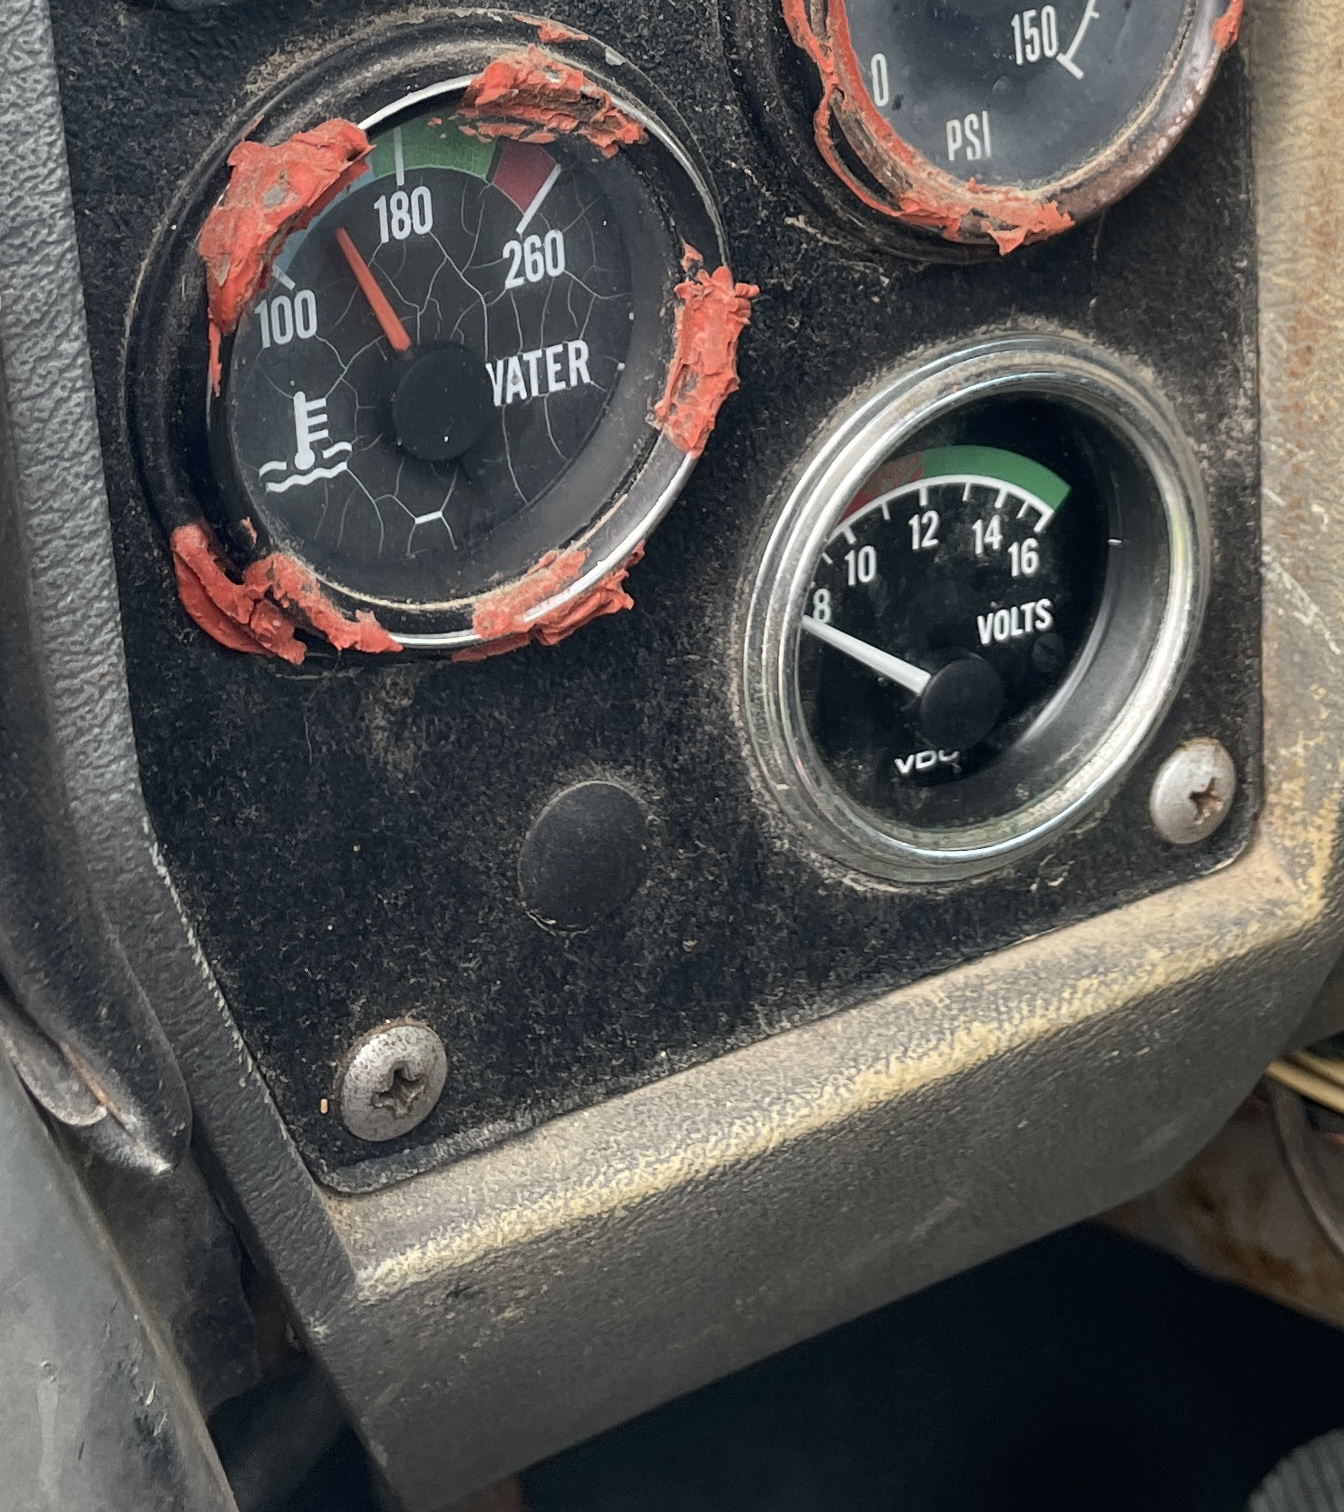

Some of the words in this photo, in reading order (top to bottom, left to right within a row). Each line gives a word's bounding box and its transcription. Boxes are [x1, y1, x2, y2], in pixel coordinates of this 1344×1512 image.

[1010, 4, 1057, 66] 150
[870, 53, 890, 107] 0
[946, 111, 992, 161] PSI
[373, 186, 434, 244] 180
[502, 229, 566, 290] 260
[255, 290, 317, 348] 100
[909, 510, 940, 551] 12
[972, 515, 1003, 555] 14
[844, 545, 877, 586] 10
[1008, 538, 1040, 578] 16
[811, 588, 832, 626] 8
[977, 598, 1053, 645] VOLTS
